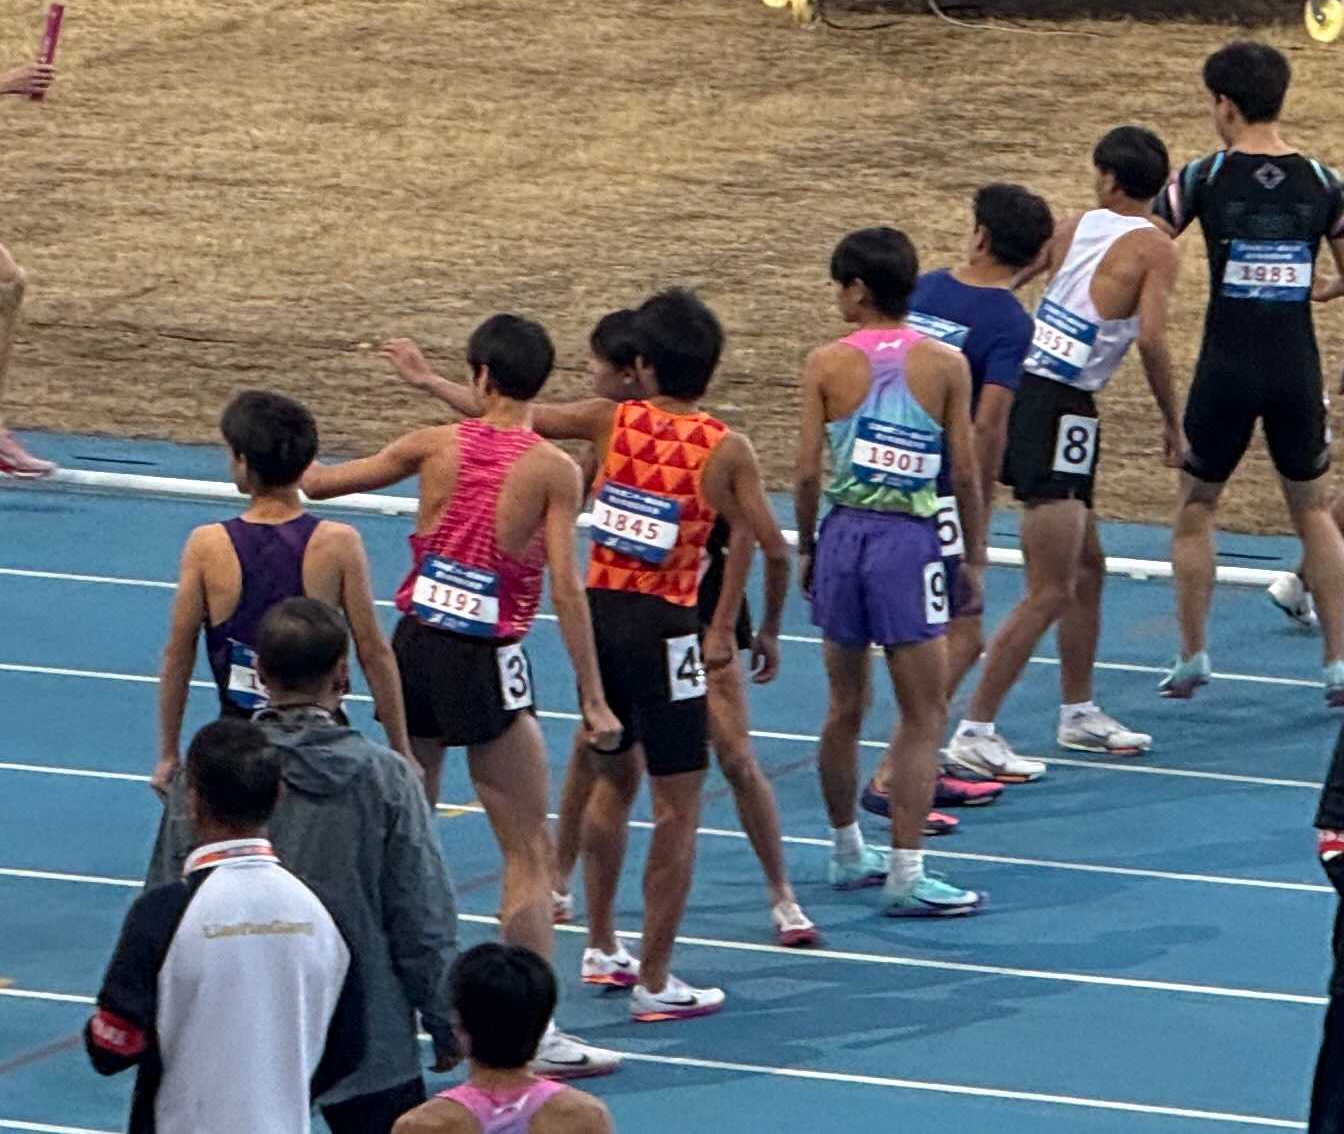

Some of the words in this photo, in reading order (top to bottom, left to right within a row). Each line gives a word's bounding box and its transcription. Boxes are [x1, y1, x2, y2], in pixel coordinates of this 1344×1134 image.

[868, 447, 925, 474] 1901
[1063, 426, 1089, 464] 8
[602, 510, 660, 540] 1845
[936, 507, 959, 546] 5
[427, 584, 483, 616] 1192
[931, 572, 946, 612] 9
[508, 655, 528, 698] 3
[676, 646, 705, 687] 4
